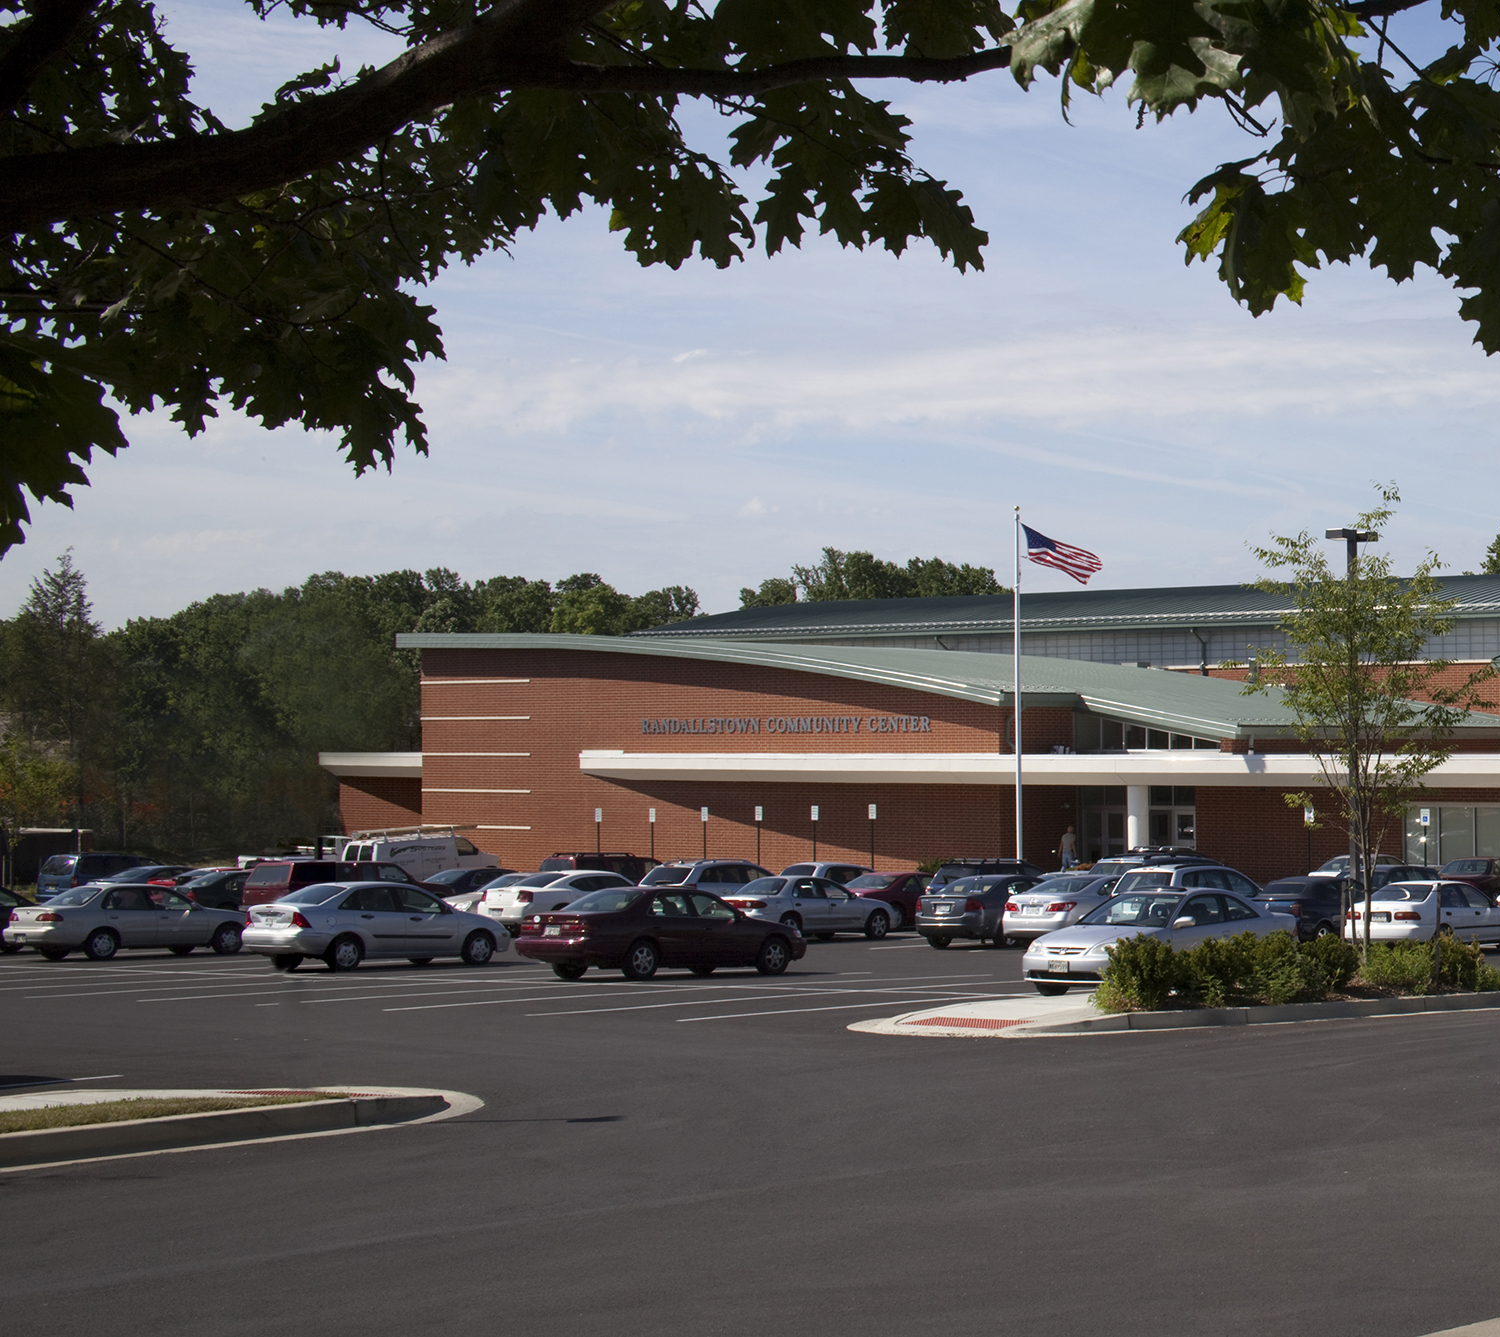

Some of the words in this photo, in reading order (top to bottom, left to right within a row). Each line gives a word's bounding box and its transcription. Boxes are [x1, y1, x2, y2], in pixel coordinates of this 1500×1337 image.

[641, 718, 760, 734] RANDALLSTOWN
[766, 716, 861, 733] COMMUNITY
[867, 716, 931, 732] CENTER
